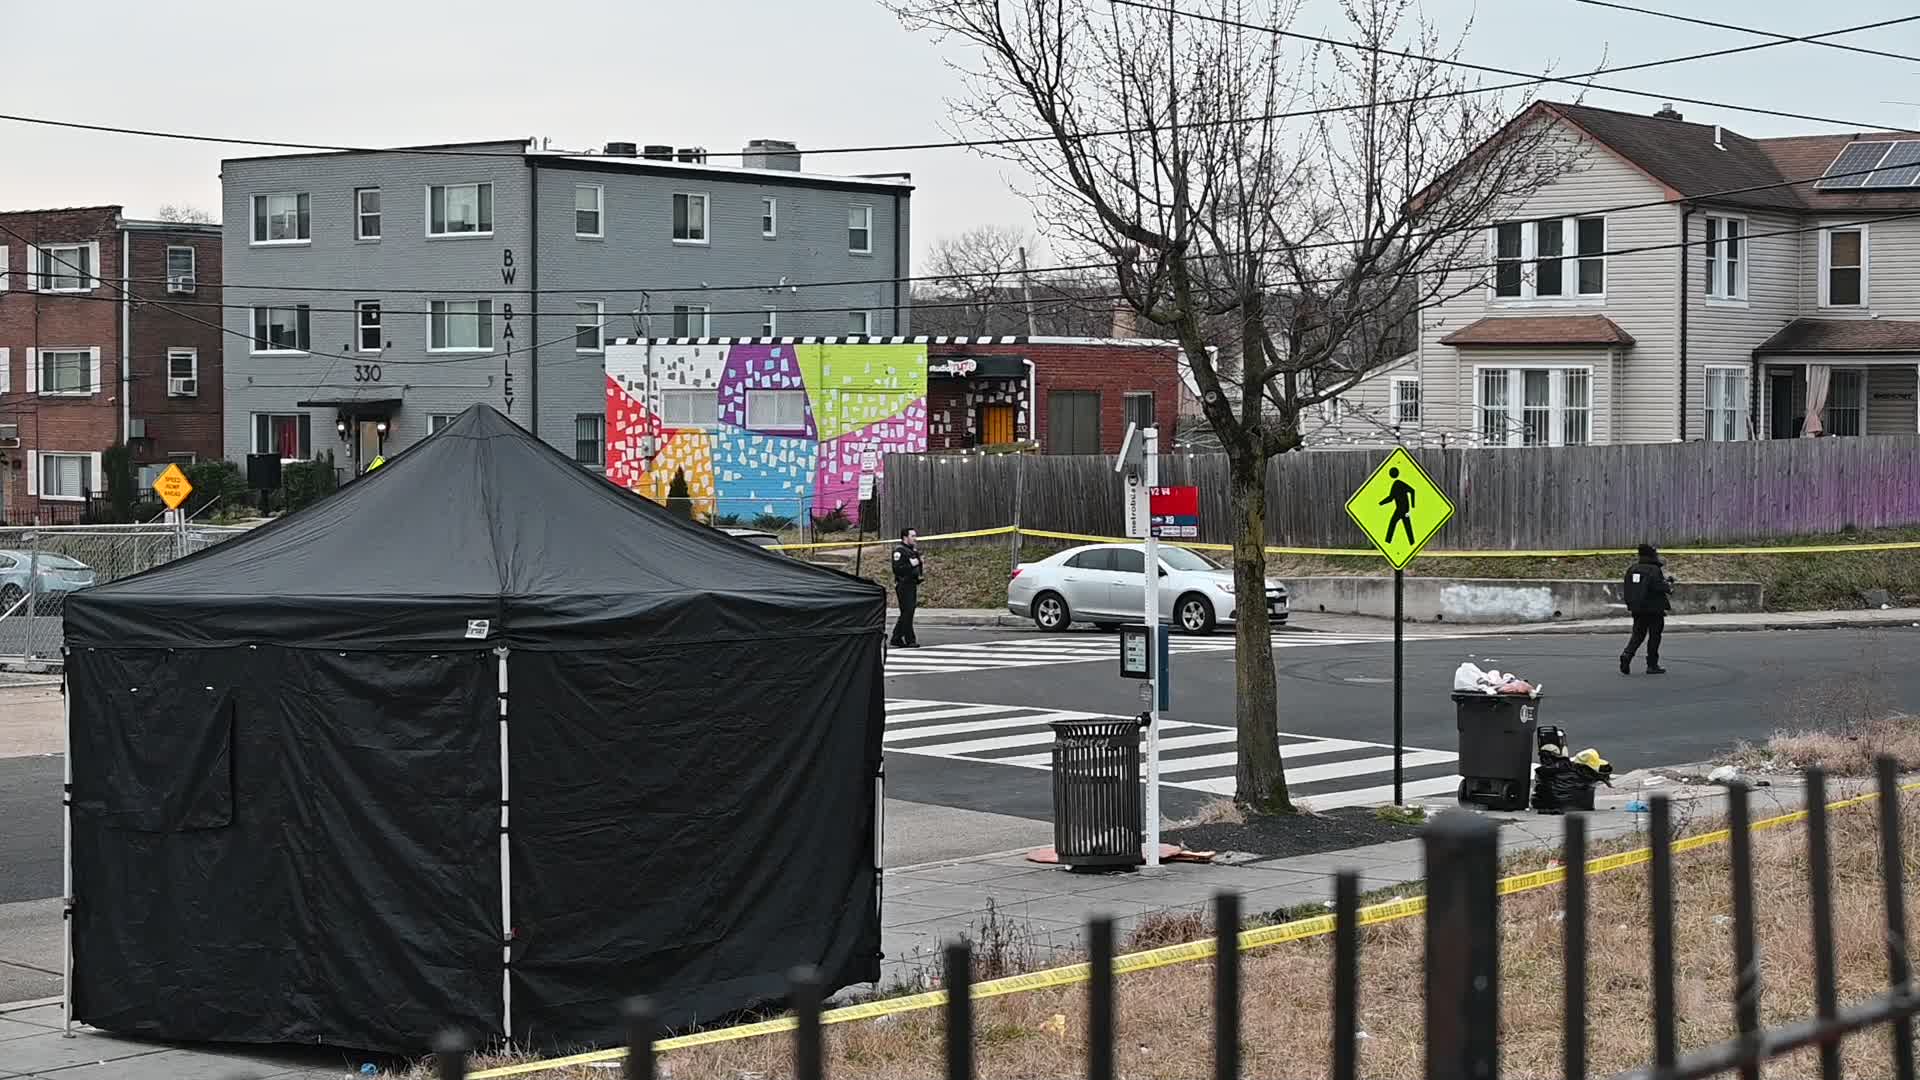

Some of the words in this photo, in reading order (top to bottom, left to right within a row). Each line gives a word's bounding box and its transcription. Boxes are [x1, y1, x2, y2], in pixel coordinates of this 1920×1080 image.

[502, 249, 516, 285] BW
[354, 364, 382, 382] 330
[503, 303, 514, 415] BAILEY
